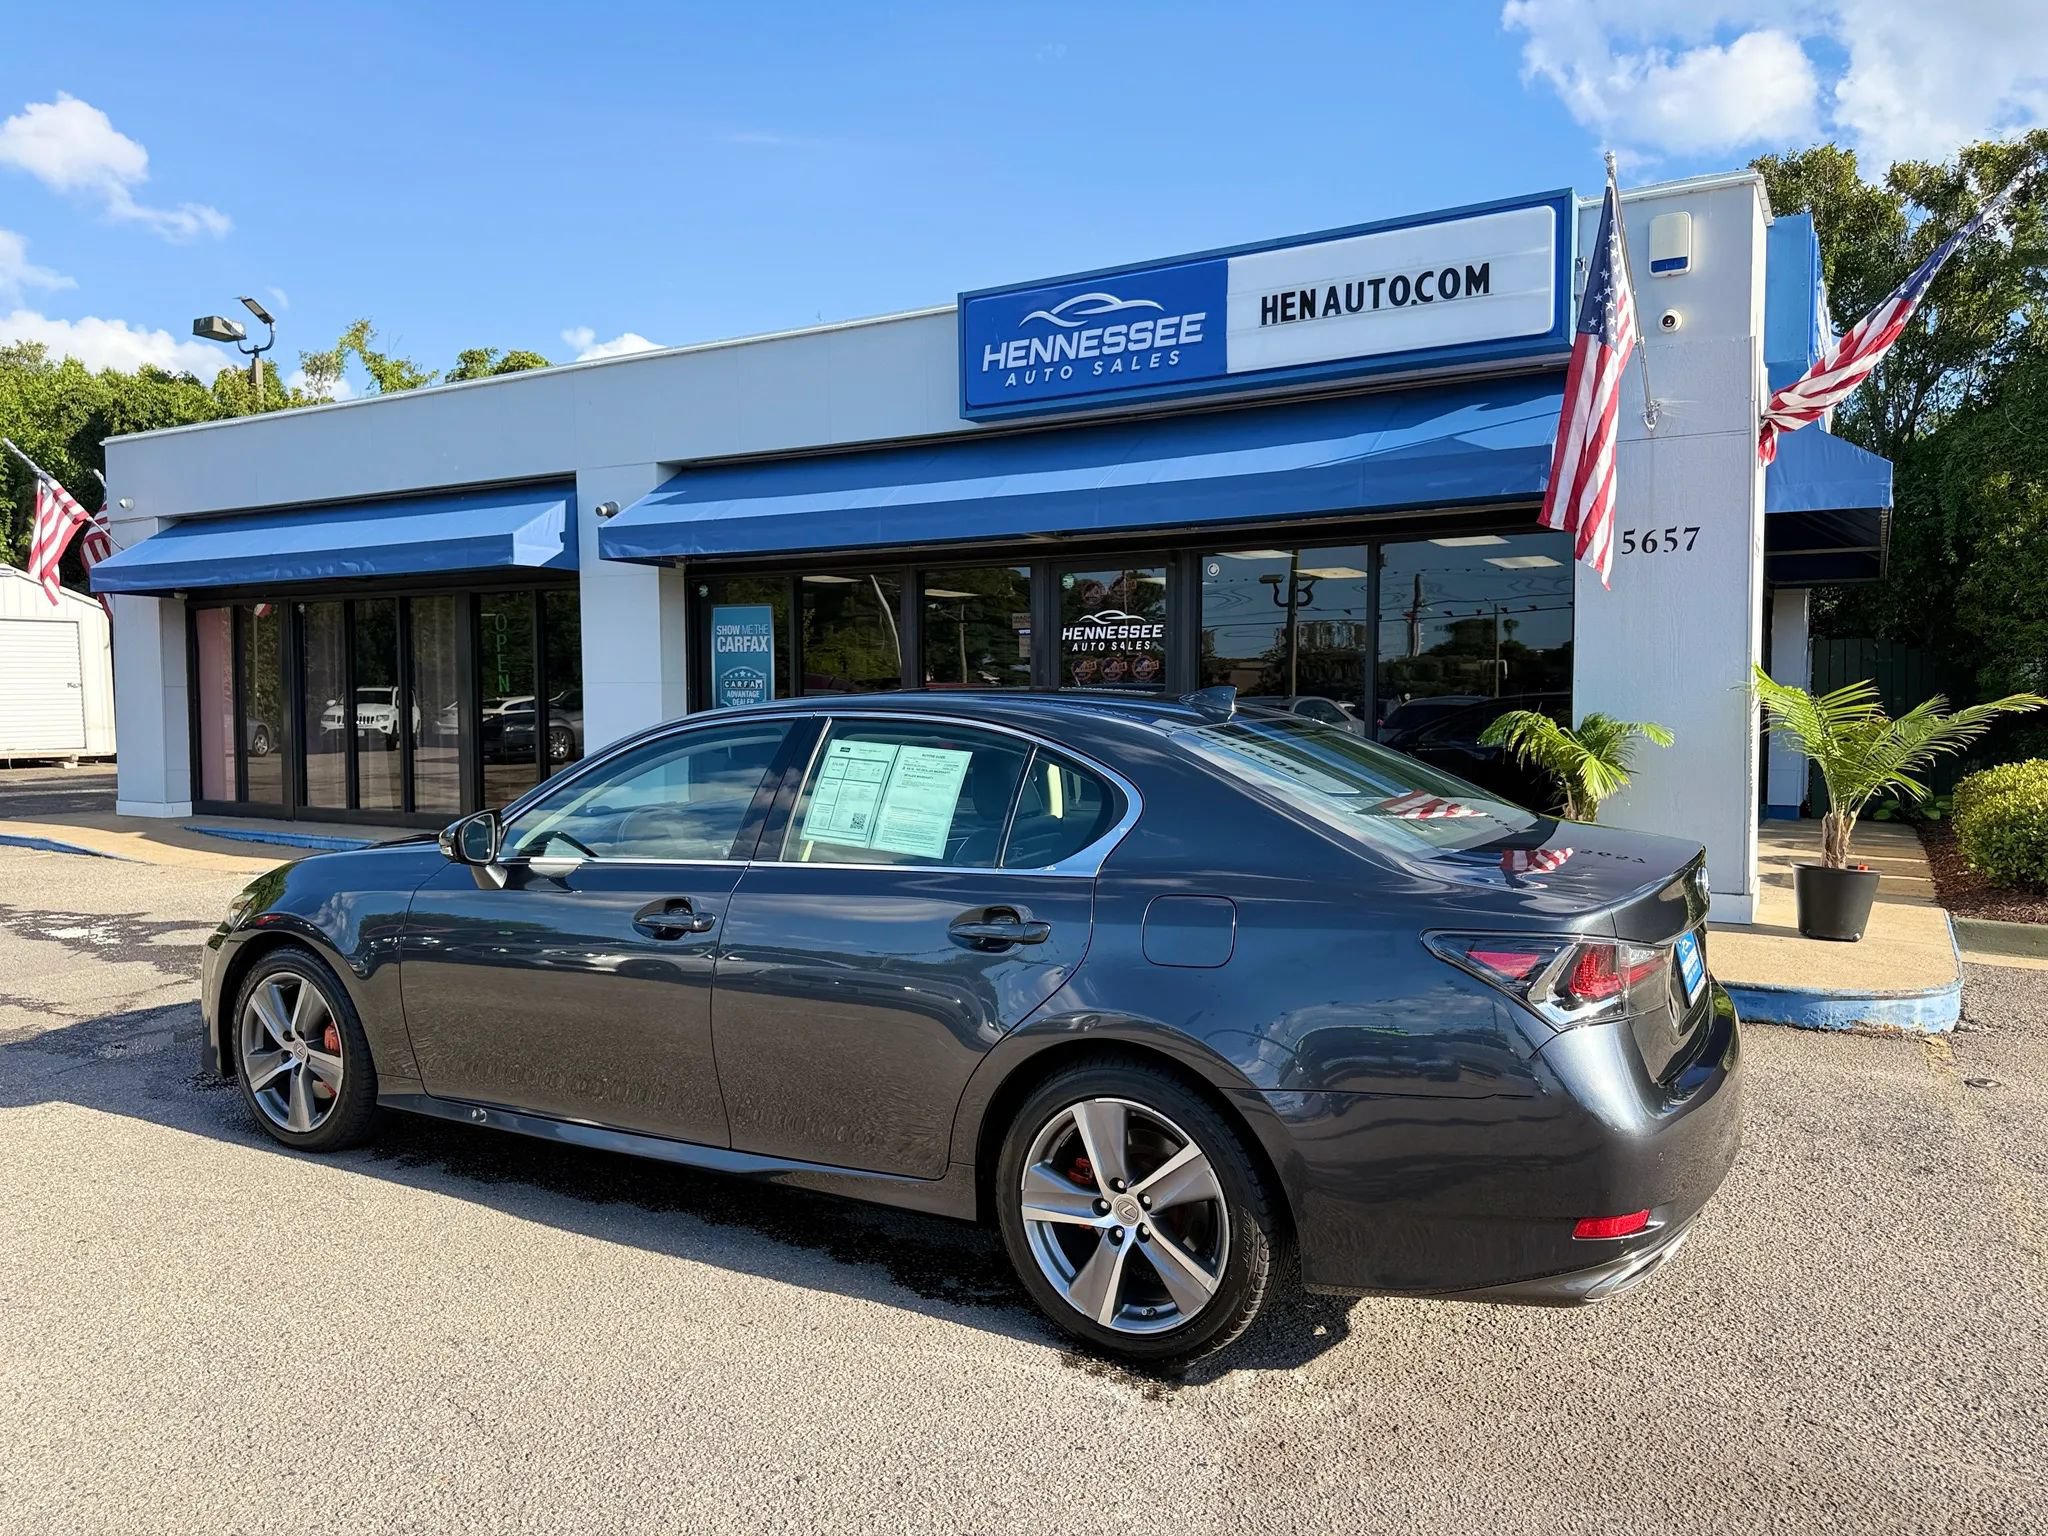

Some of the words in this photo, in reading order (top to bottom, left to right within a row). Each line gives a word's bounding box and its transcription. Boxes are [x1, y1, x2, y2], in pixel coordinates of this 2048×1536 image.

[981, 311, 1207, 372] HENNESSEE
[1004, 365, 1073, 388] AUTO
[1092, 350, 1181, 376] SALES
[1621, 525, 1701, 555] 5657
[716, 625, 740, 635] SHOW
[742, 624, 754, 635] ME
[754, 624, 769, 635] THE
[1062, 624, 1164, 640] HENNESSEE
[717, 635, 769, 652] CARFAX
[1071, 641, 1106, 652] AUTO
[1111, 640, 1151, 651] SALES
[726, 690, 760, 698] ADVANTAGE
